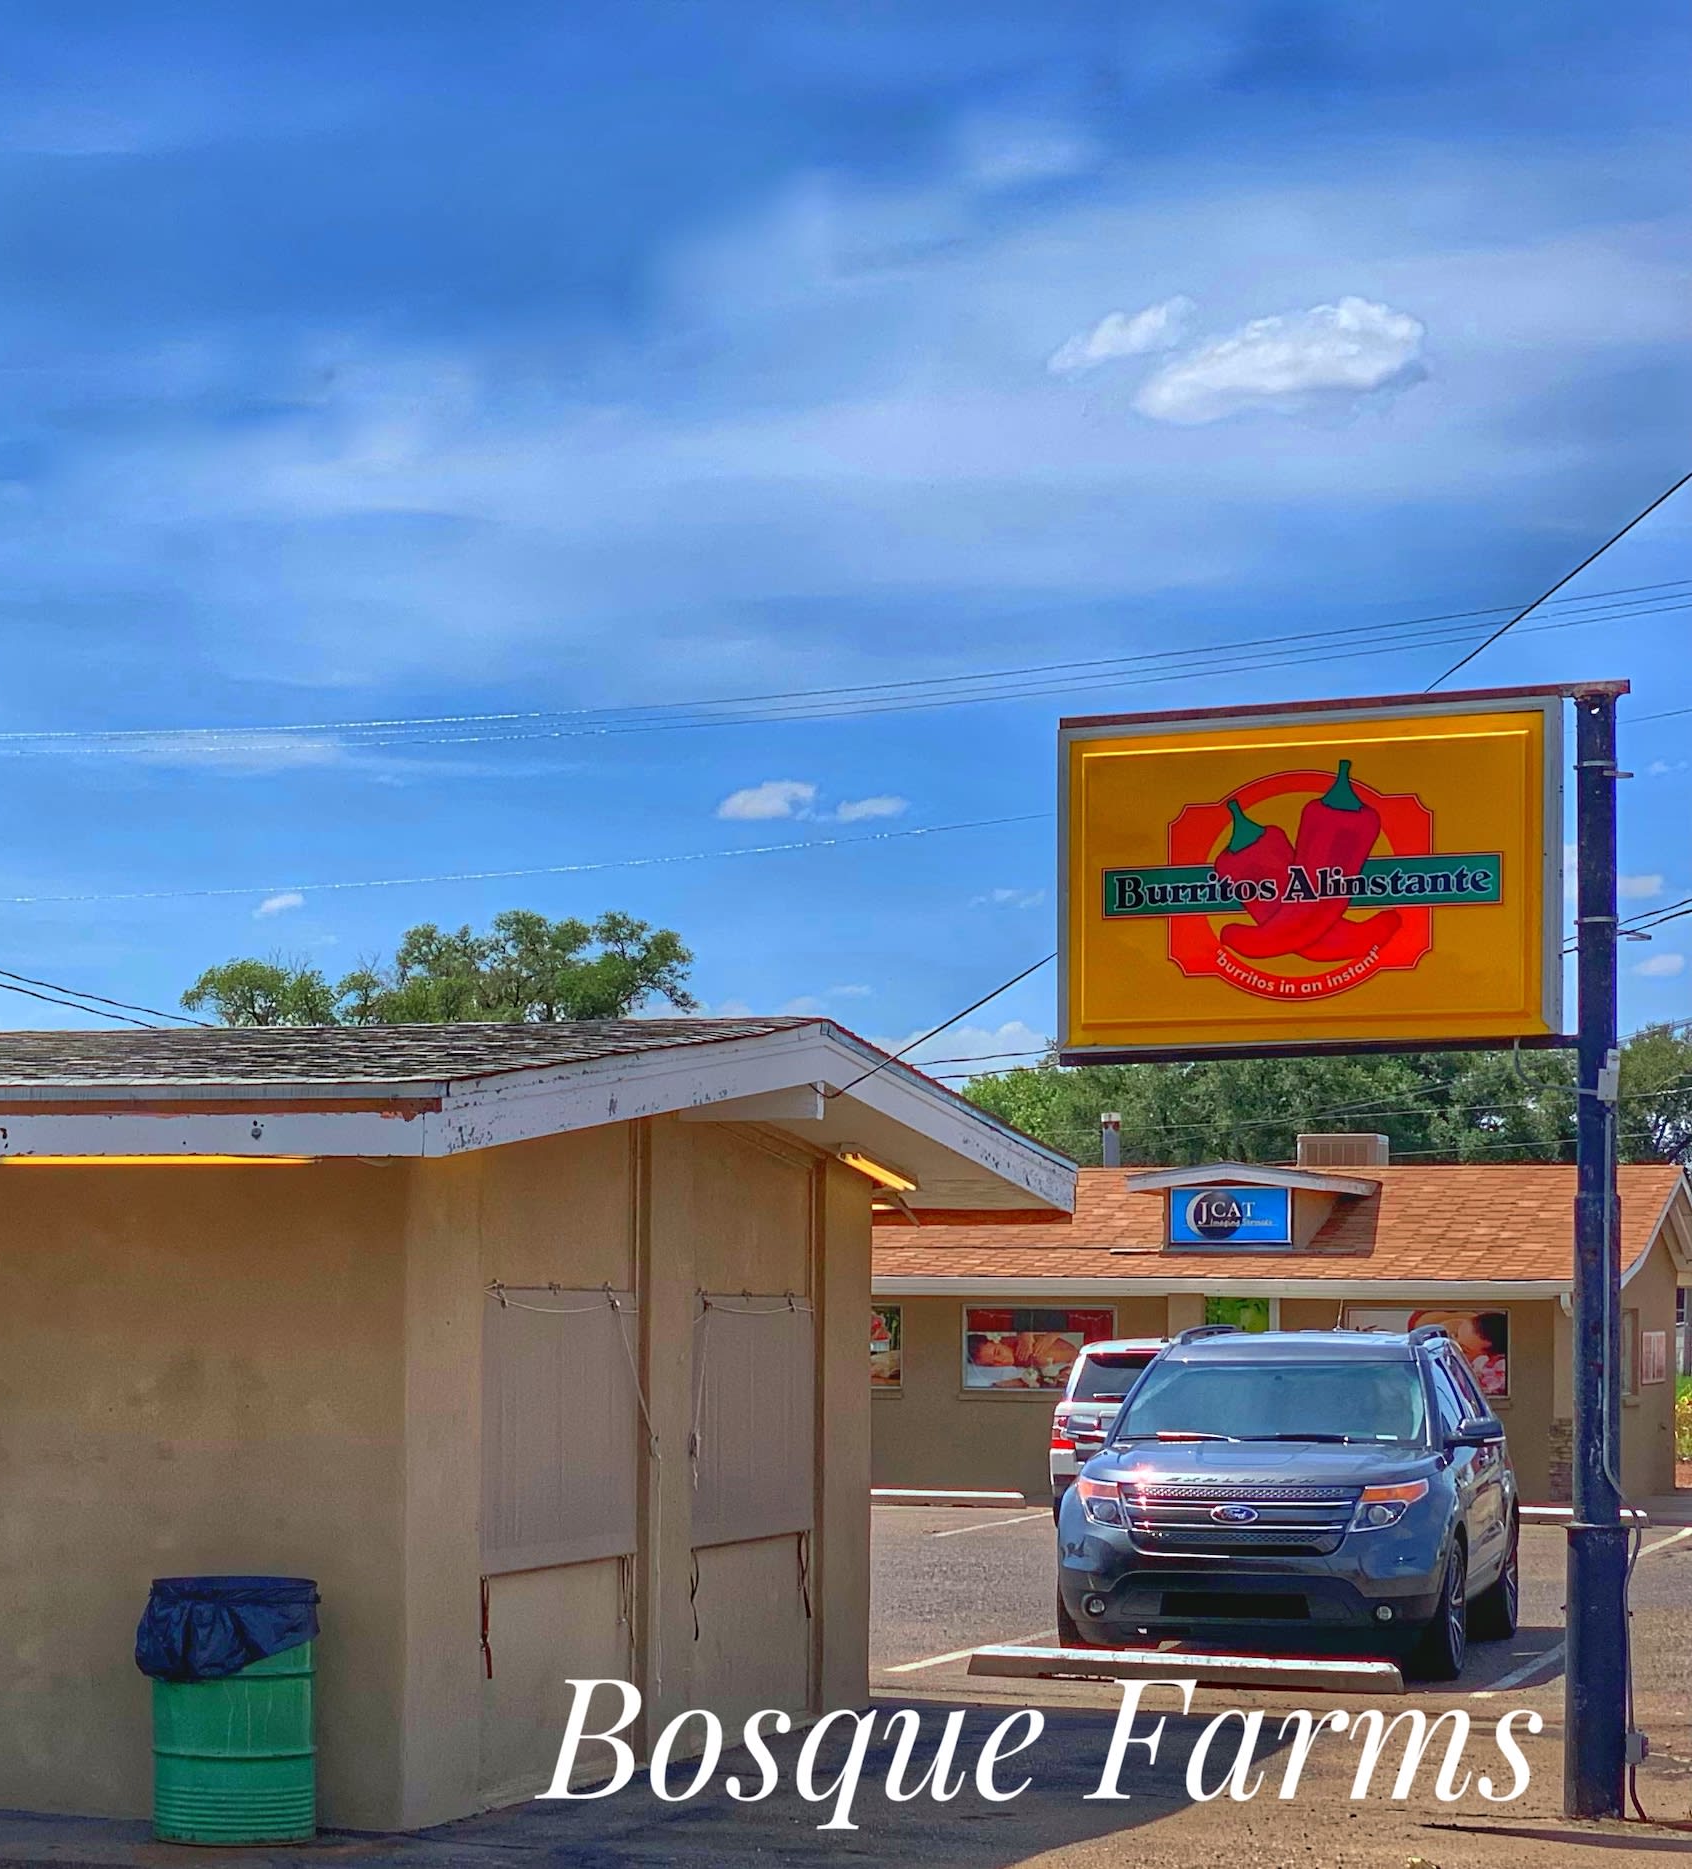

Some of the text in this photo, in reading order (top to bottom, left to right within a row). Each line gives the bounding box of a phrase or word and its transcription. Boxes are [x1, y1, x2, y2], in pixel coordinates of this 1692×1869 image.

[1114, 865, 1494, 911] Burritos Alinstante
[1280, 980, 1295, 993] in
[1301, 981, 1323, 993] an
